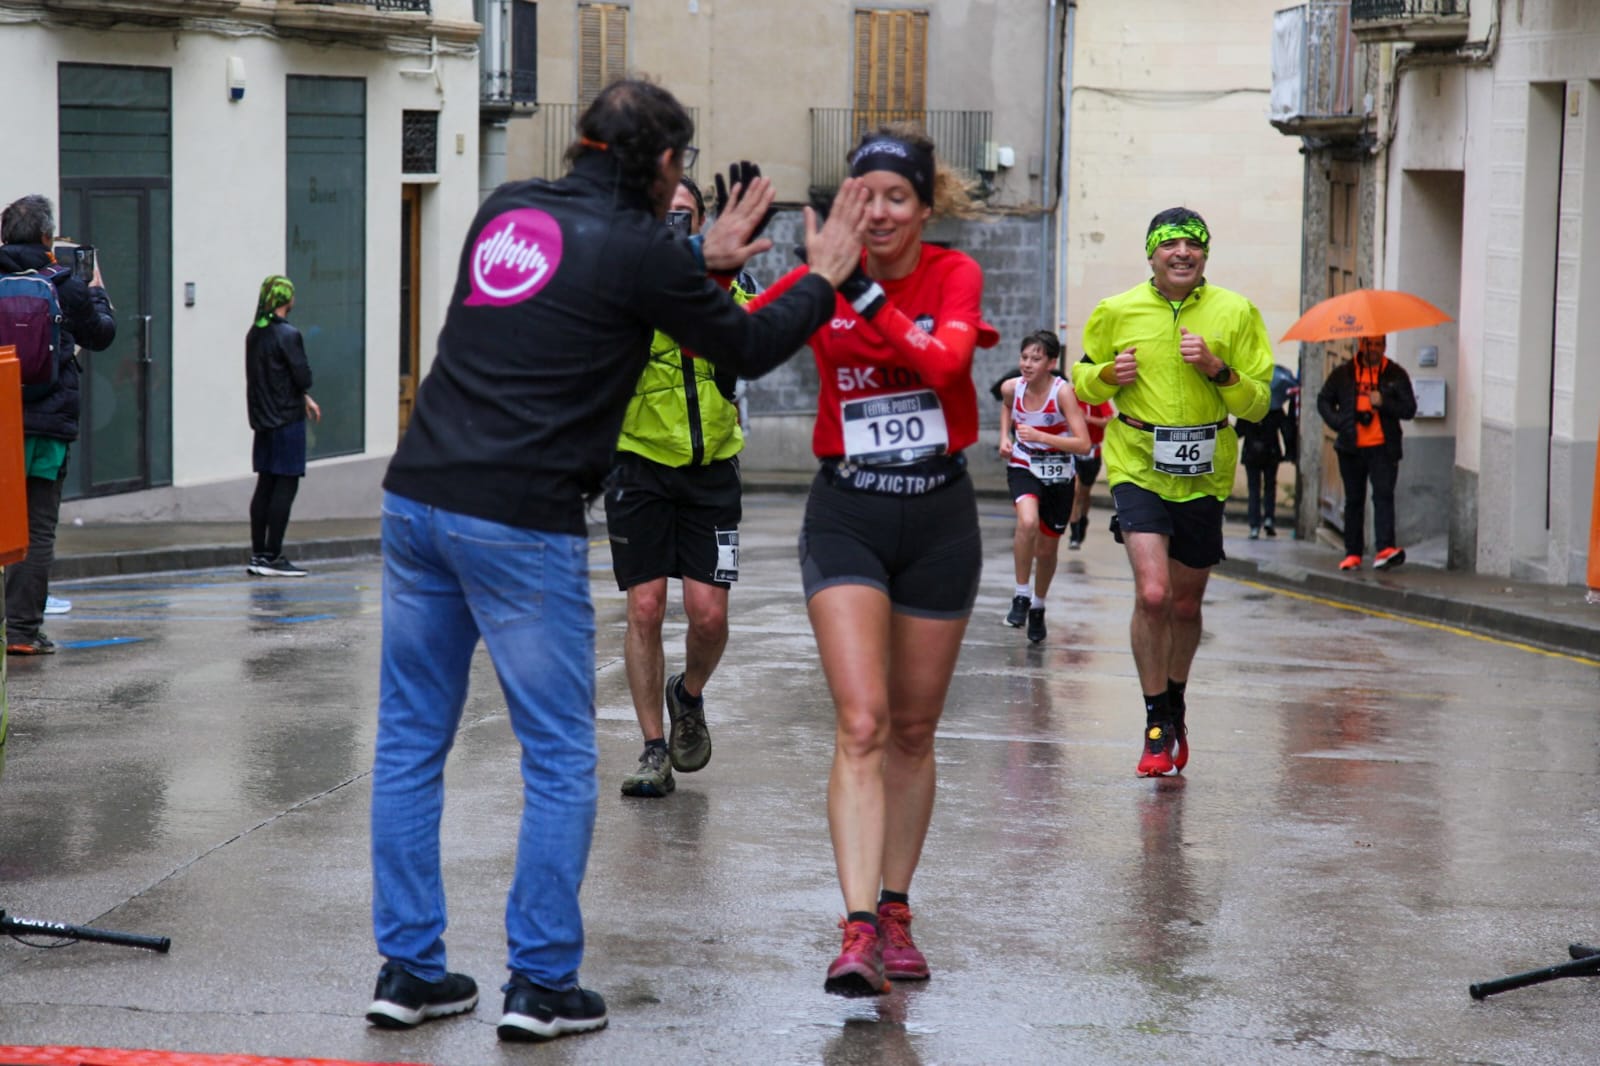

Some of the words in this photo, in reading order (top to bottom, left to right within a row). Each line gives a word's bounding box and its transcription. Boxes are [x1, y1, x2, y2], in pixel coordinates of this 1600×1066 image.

[868, 416, 924, 447] 190
[1174, 443, 1200, 462] 46
[1040, 465, 1063, 476] 139
[854, 471, 876, 489] UP
